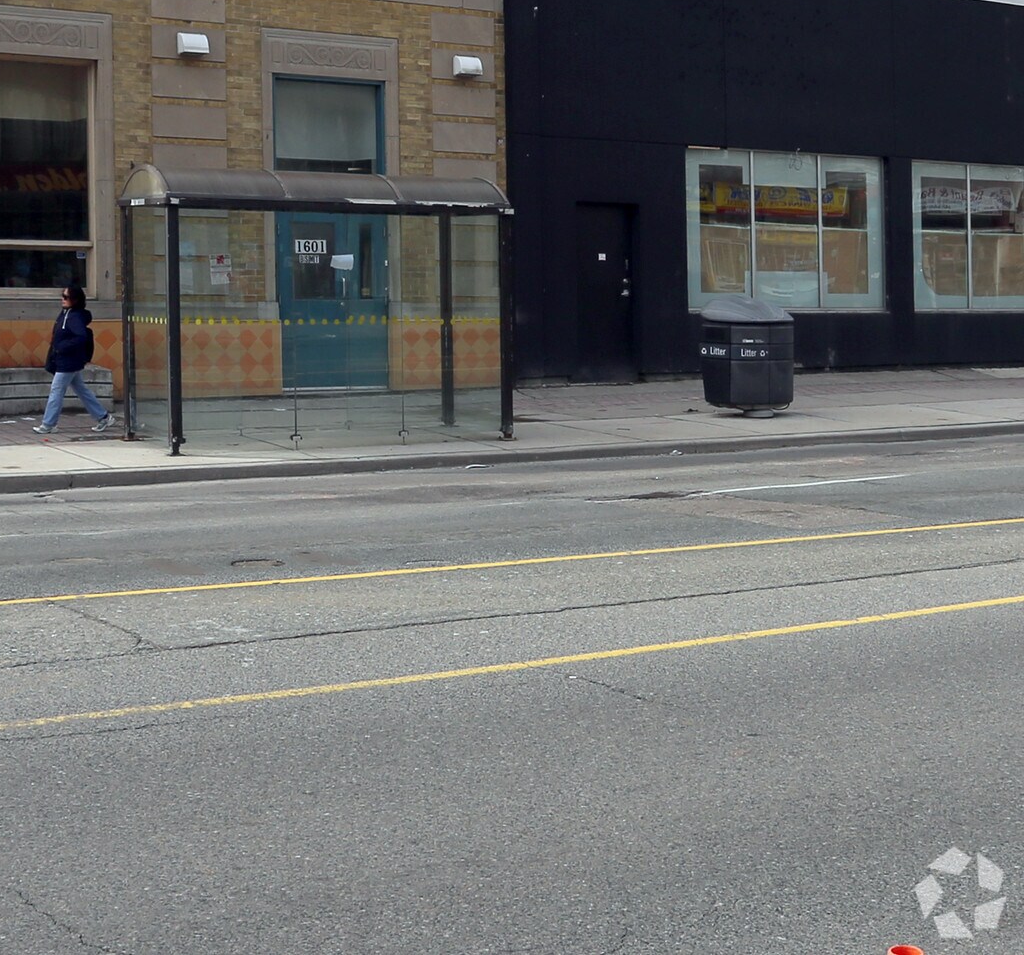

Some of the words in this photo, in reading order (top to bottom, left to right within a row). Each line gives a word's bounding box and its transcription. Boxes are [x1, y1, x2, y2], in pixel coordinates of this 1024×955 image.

[297, 240, 325, 253] 1601
[709, 346, 726, 356] Litter
[740, 348, 756, 357] Litter
